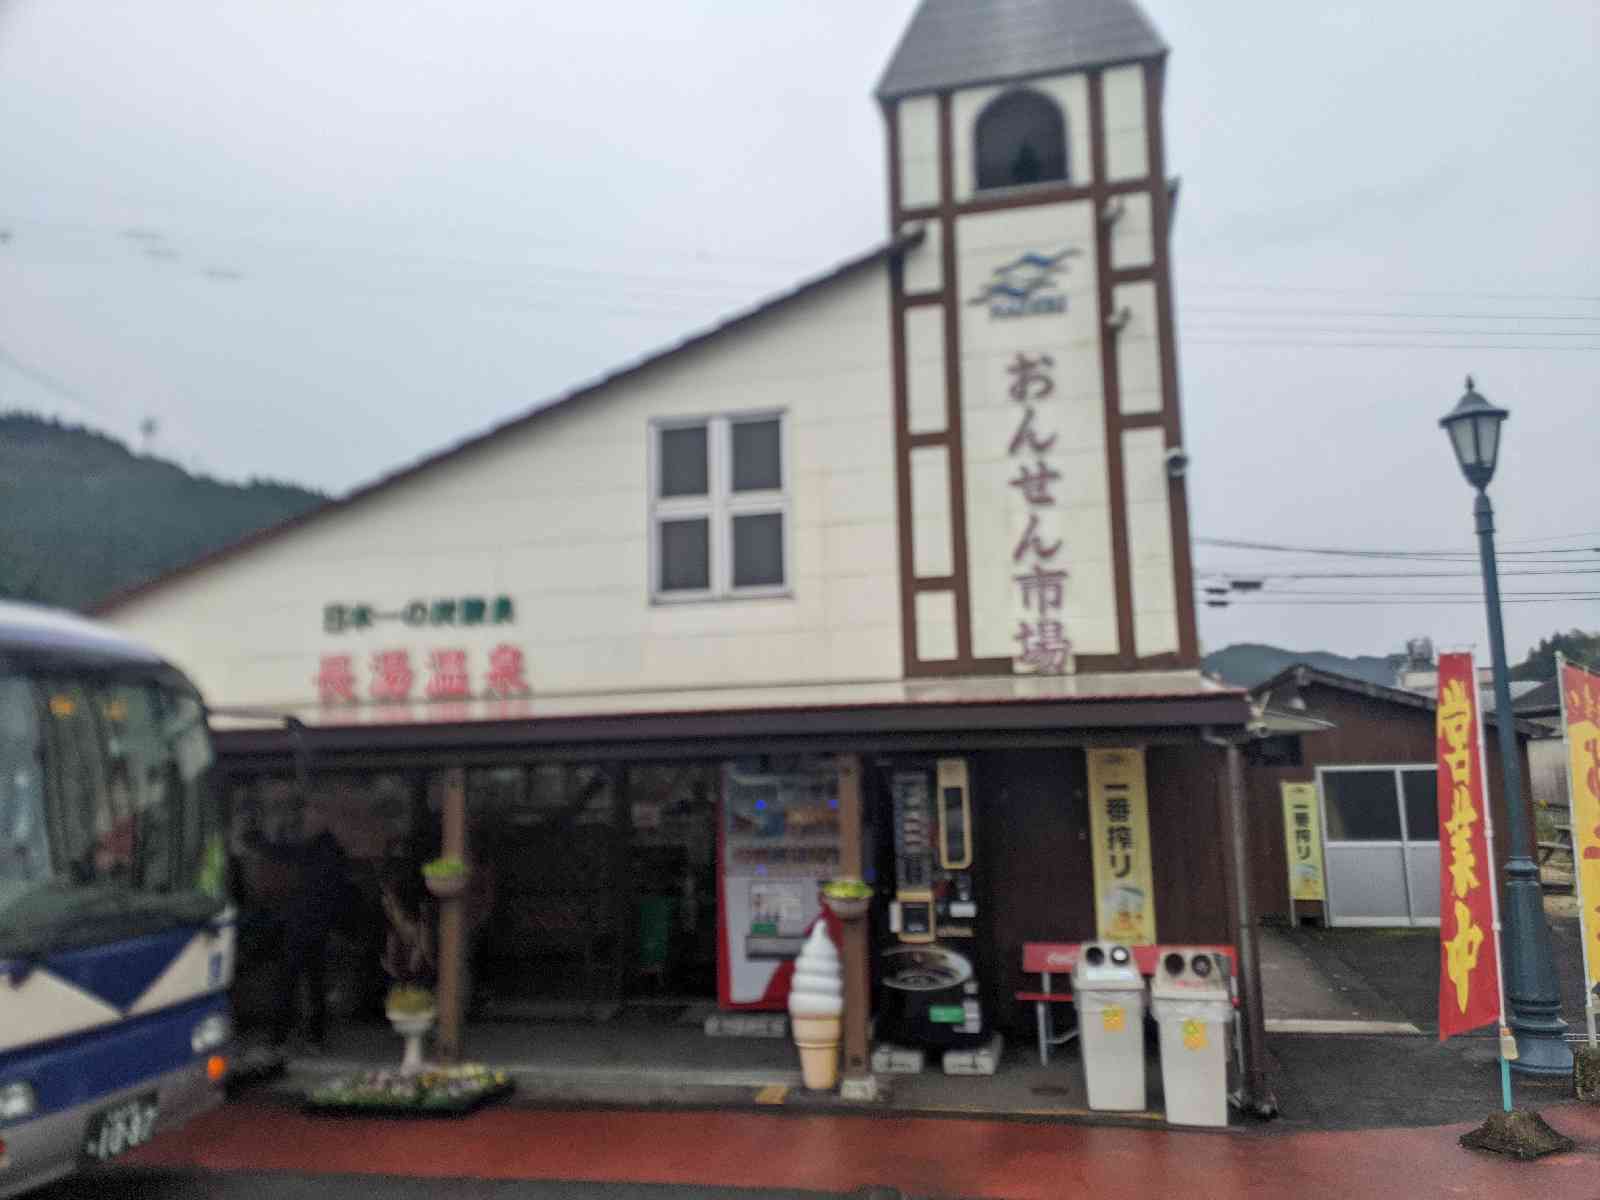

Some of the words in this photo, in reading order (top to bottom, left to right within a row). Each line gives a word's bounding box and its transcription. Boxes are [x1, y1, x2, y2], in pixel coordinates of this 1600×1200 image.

[1006, 352, 1073, 676] おんせん市場
[315, 643, 530, 706] 長湯温泉
[1104, 783, 1132, 878] 一番搾り
[1293, 803, 1312, 860] 一番搾り
[1438, 677, 1484, 1015] 営業中
